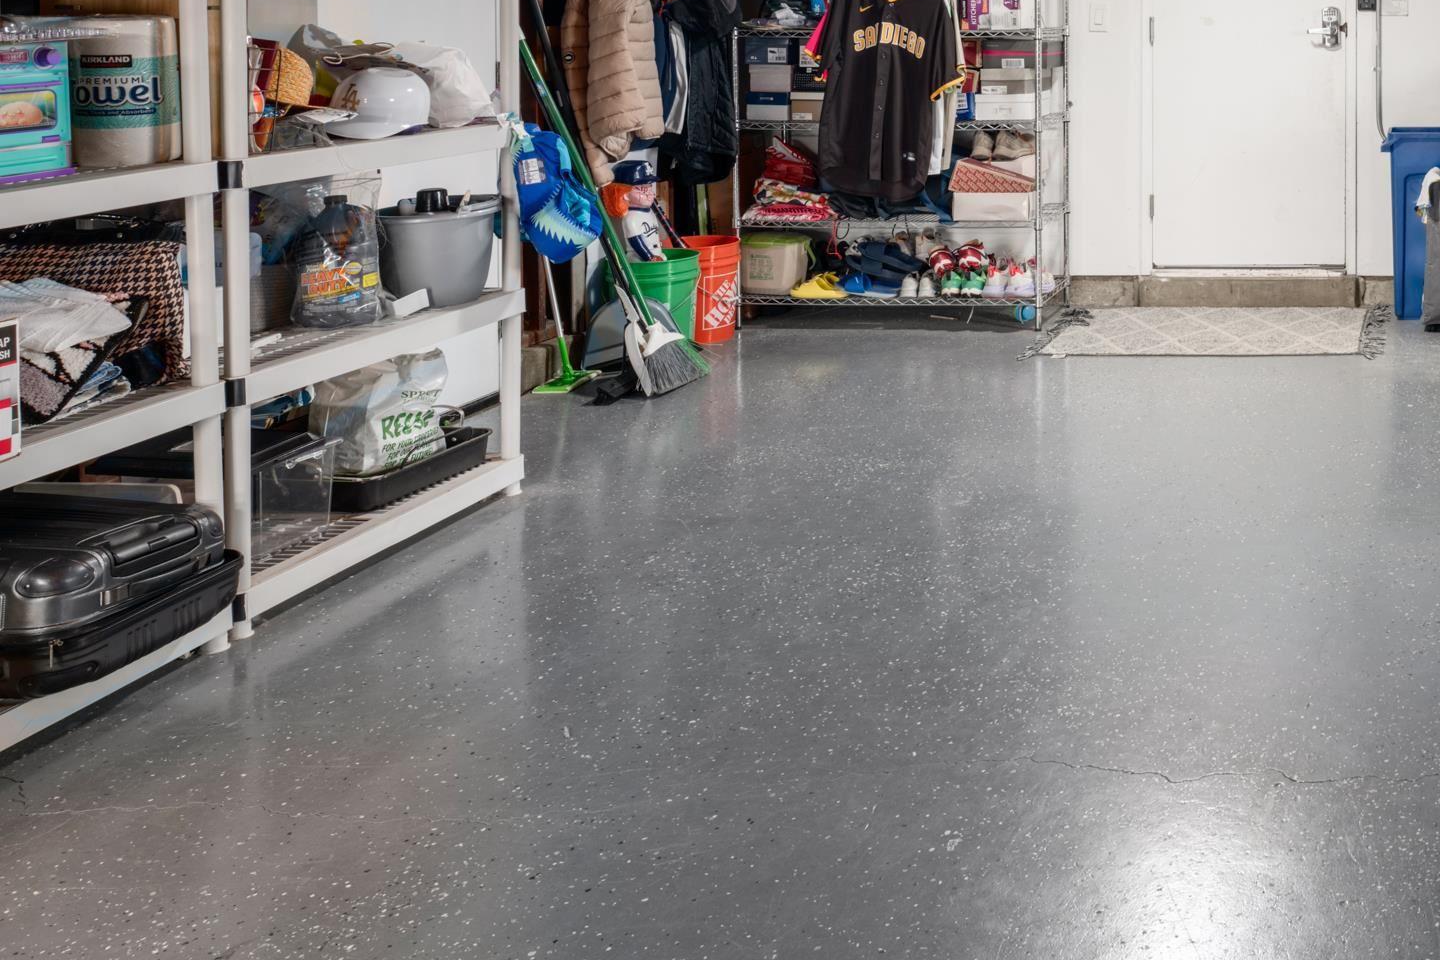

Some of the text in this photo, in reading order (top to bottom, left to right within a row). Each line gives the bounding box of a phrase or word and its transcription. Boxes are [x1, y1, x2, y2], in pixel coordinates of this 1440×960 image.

[879, 21, 926, 59] DIEGO
[75, 76, 162, 103] owel
[79, 76, 140, 84] PREMIUM
[711, 279, 731, 302] THE
